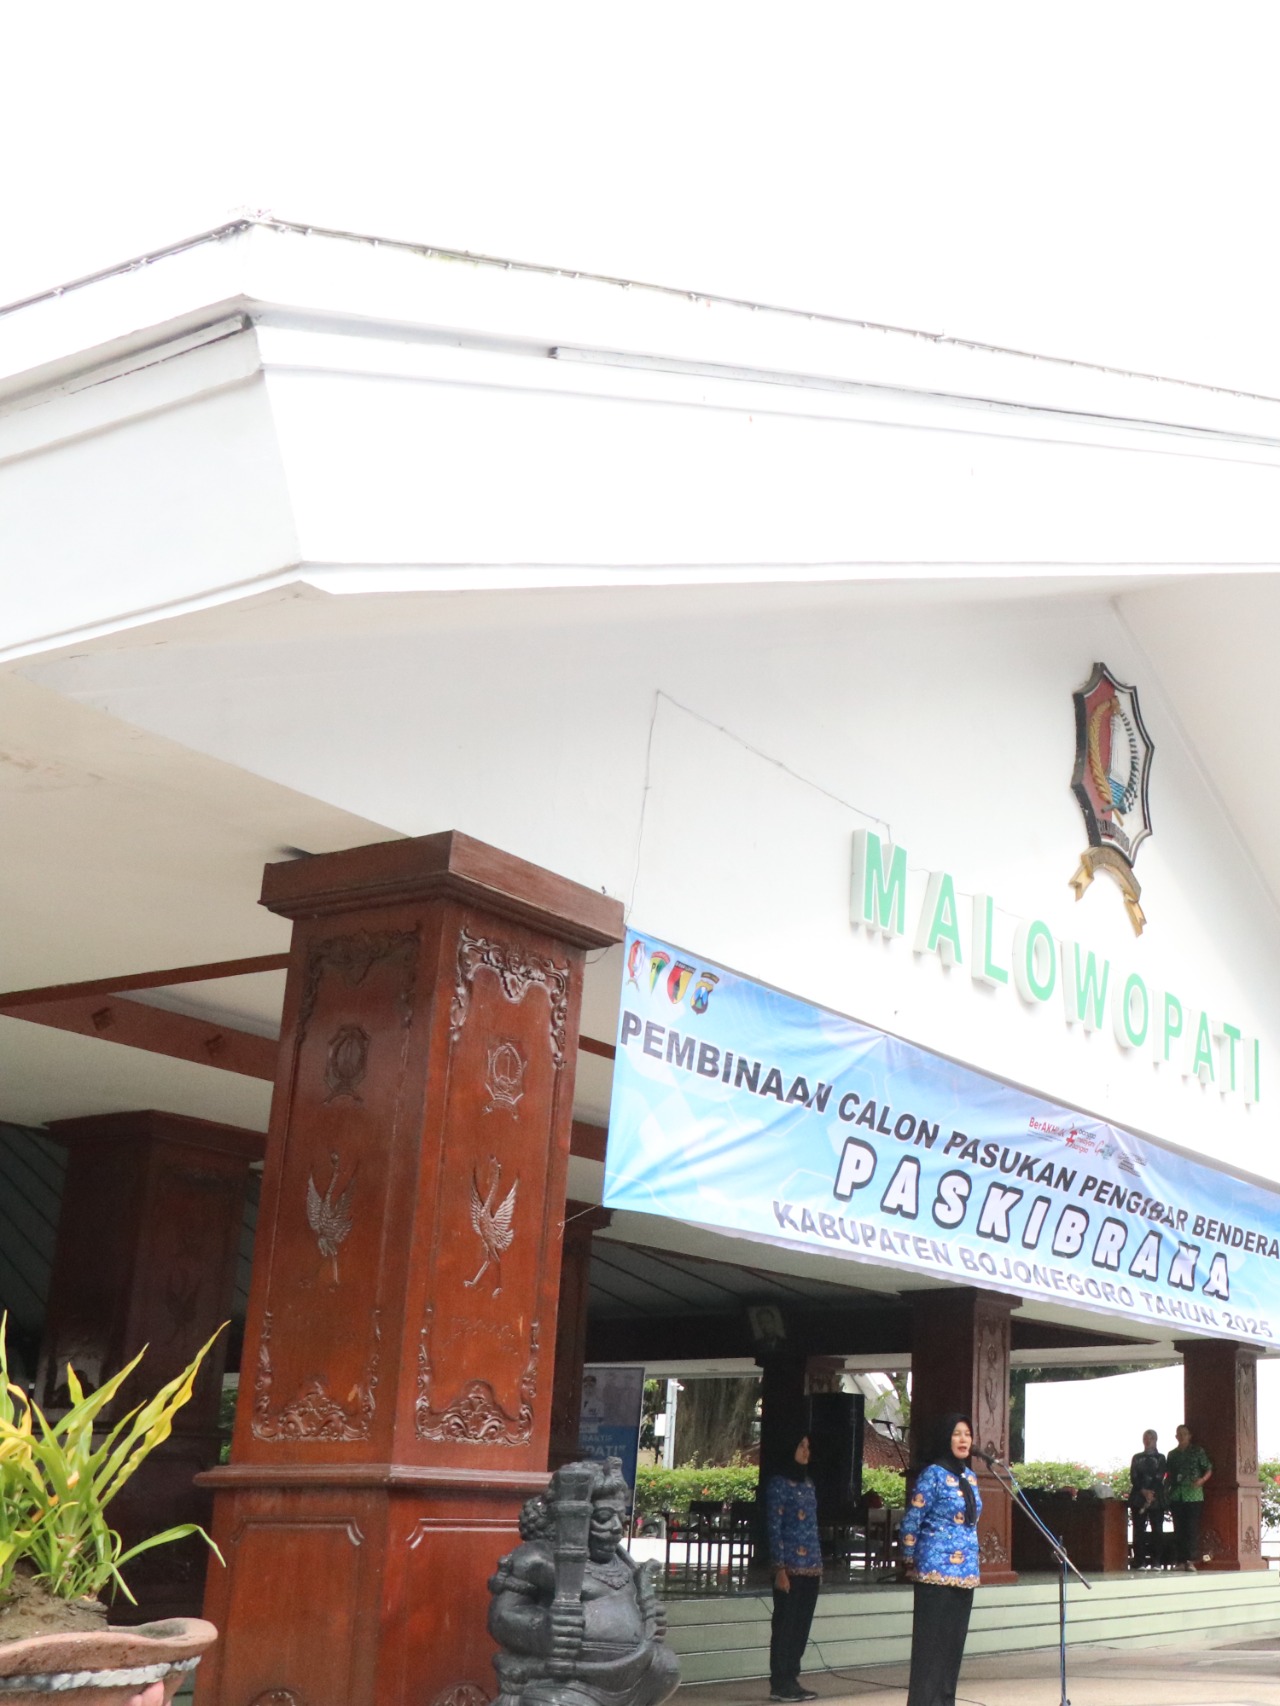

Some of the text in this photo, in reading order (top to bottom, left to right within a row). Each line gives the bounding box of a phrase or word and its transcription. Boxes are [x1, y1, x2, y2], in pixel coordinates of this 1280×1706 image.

[852, 828, 1260, 1104] MALOWOPATI
[620, 1010, 833, 1113] PEMBINAAN
[838, 1092, 940, 1149] CALON
[943, 1130, 1077, 1193] PASUKAN
[1078, 1174, 1189, 1232] PENGIBAR
[1191, 1214, 1280, 1260] BENDERA
[832, 1135, 1230, 1302] PASKIBRAKA
[772, 1200, 1274, 1339] KABUPATEN BOJONEGORO TAHUN 2025
